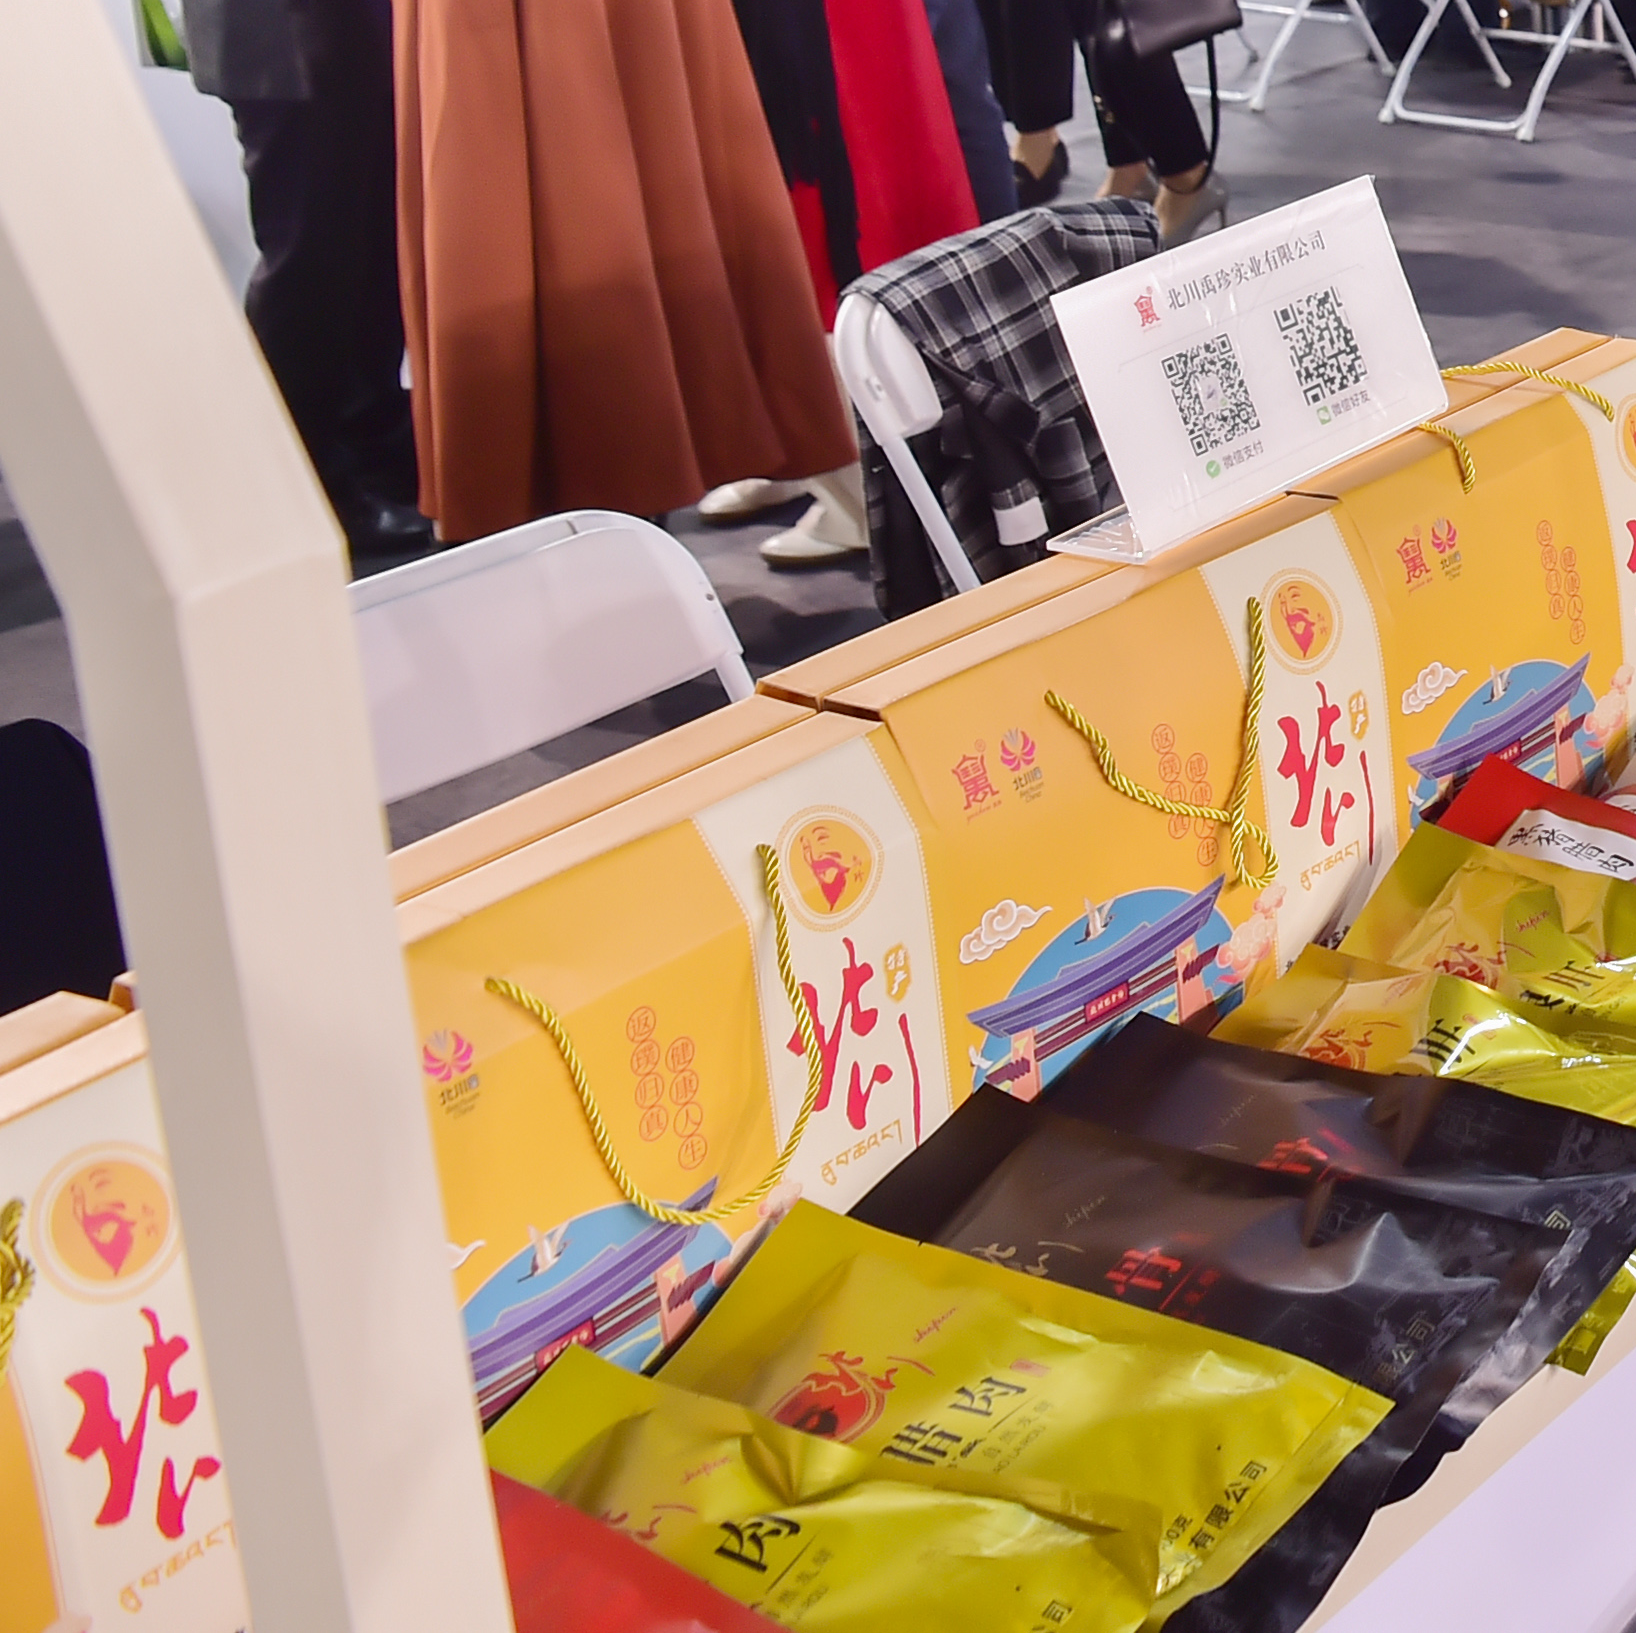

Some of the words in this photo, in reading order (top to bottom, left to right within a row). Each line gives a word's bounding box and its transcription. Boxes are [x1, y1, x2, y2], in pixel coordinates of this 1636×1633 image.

[1166, 228, 1327, 312] 北川禹珍实业有限公司
[1221, 440, 1265, 471] 微信支付
[1330, 388, 1371, 417] 微信好友
[1277, 681, 1376, 867] 北川
[625, 1005, 670, 1144] 返璞归真
[786, 936, 923, 1149] 北川
[664, 1035, 709, 1172] 健康人生
[1187, 1459, 1268, 1551] 有限公司
